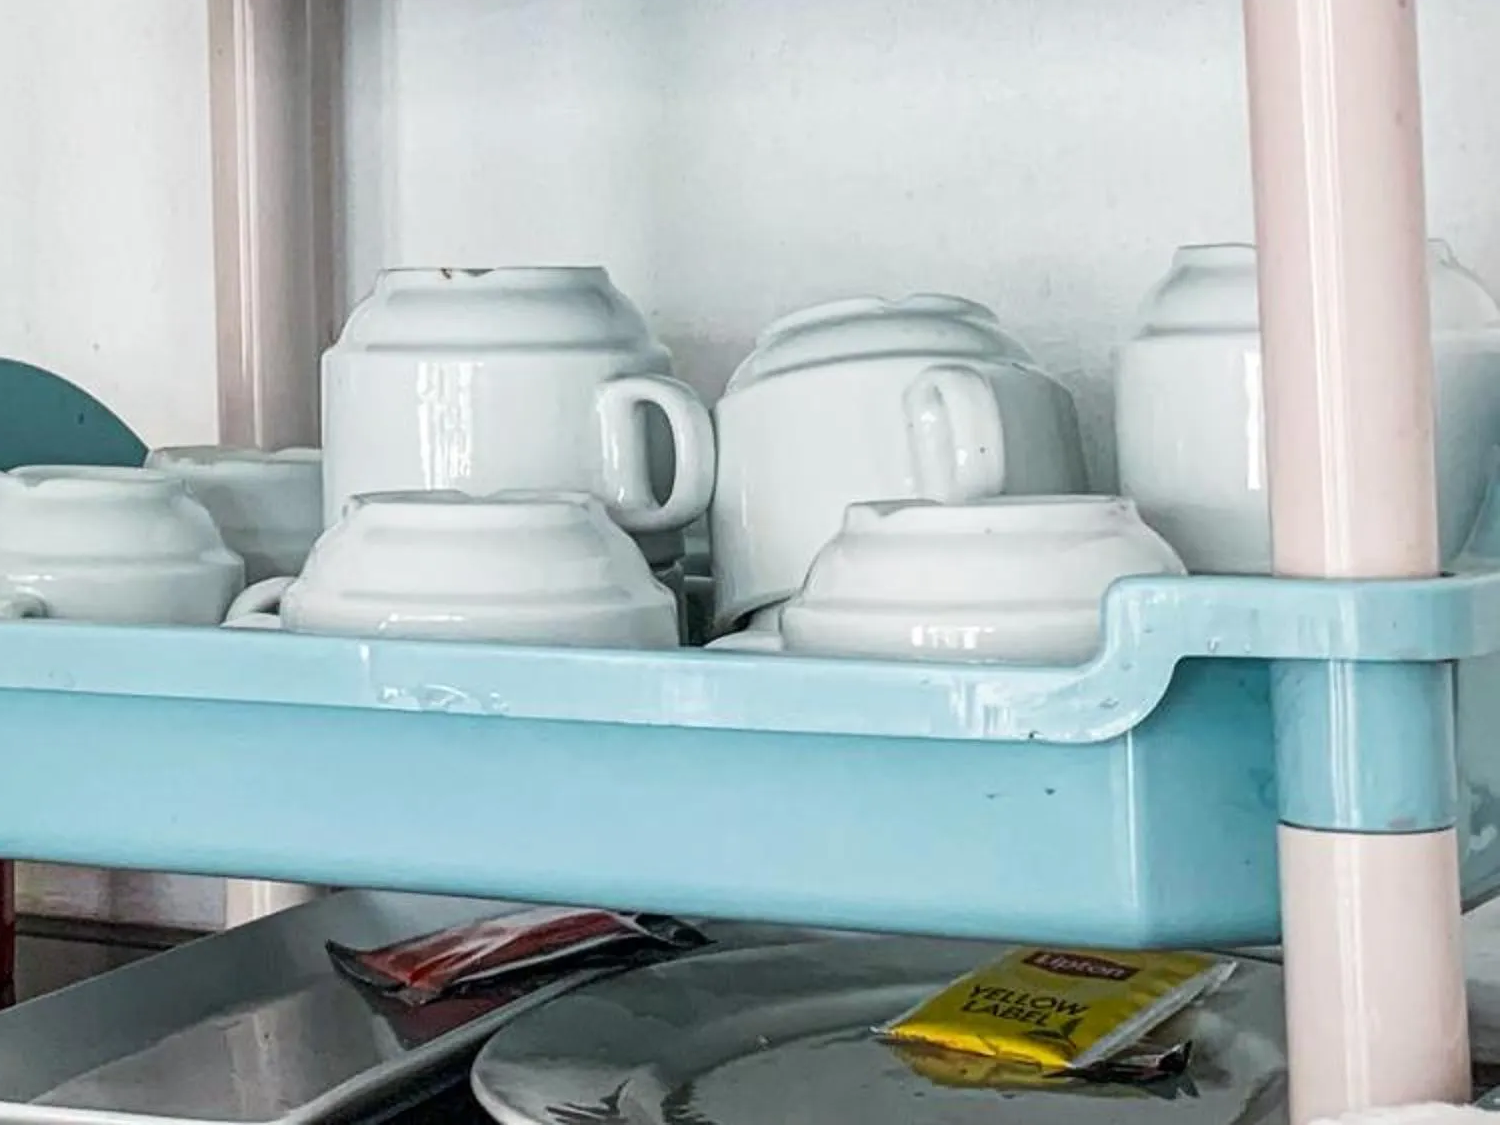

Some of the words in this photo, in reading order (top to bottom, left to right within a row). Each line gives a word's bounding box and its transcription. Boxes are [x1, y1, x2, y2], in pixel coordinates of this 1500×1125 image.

[1034, 954, 1126, 977] Lipton
[960, 999, 1050, 1027] LABEL
[970, 984, 1089, 1015] YELLOW
